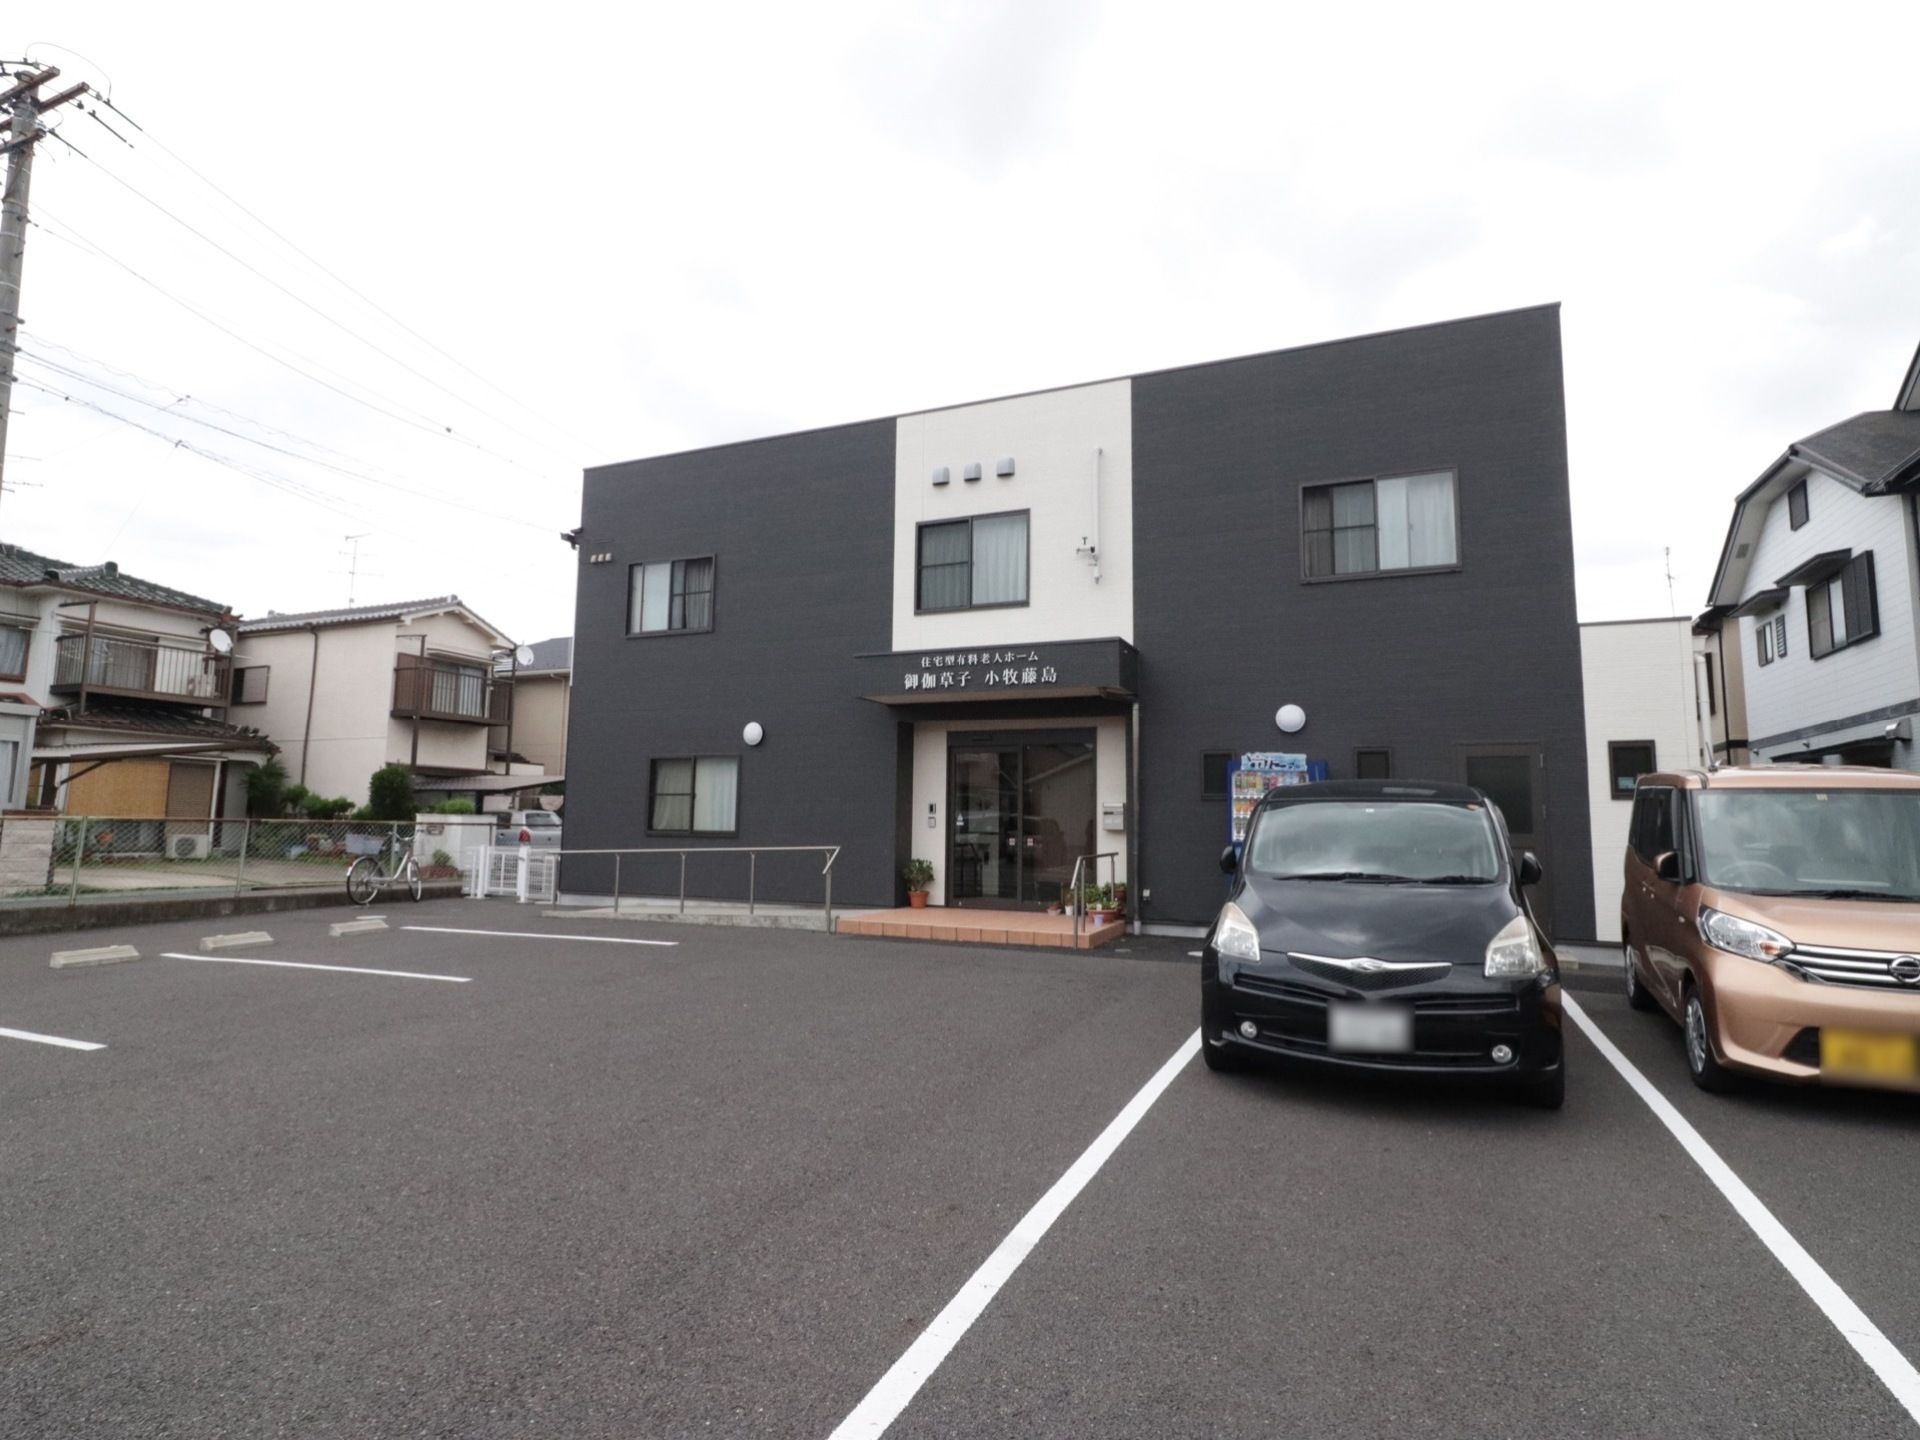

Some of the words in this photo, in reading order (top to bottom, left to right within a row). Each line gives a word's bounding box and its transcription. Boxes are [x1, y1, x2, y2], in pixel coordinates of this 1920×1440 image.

[921, 651, 1039, 668] 住宅型有料老人ホーム
[904, 671, 972, 690] 御伽草子
[984, 666, 1058, 686] 小牧藤島
